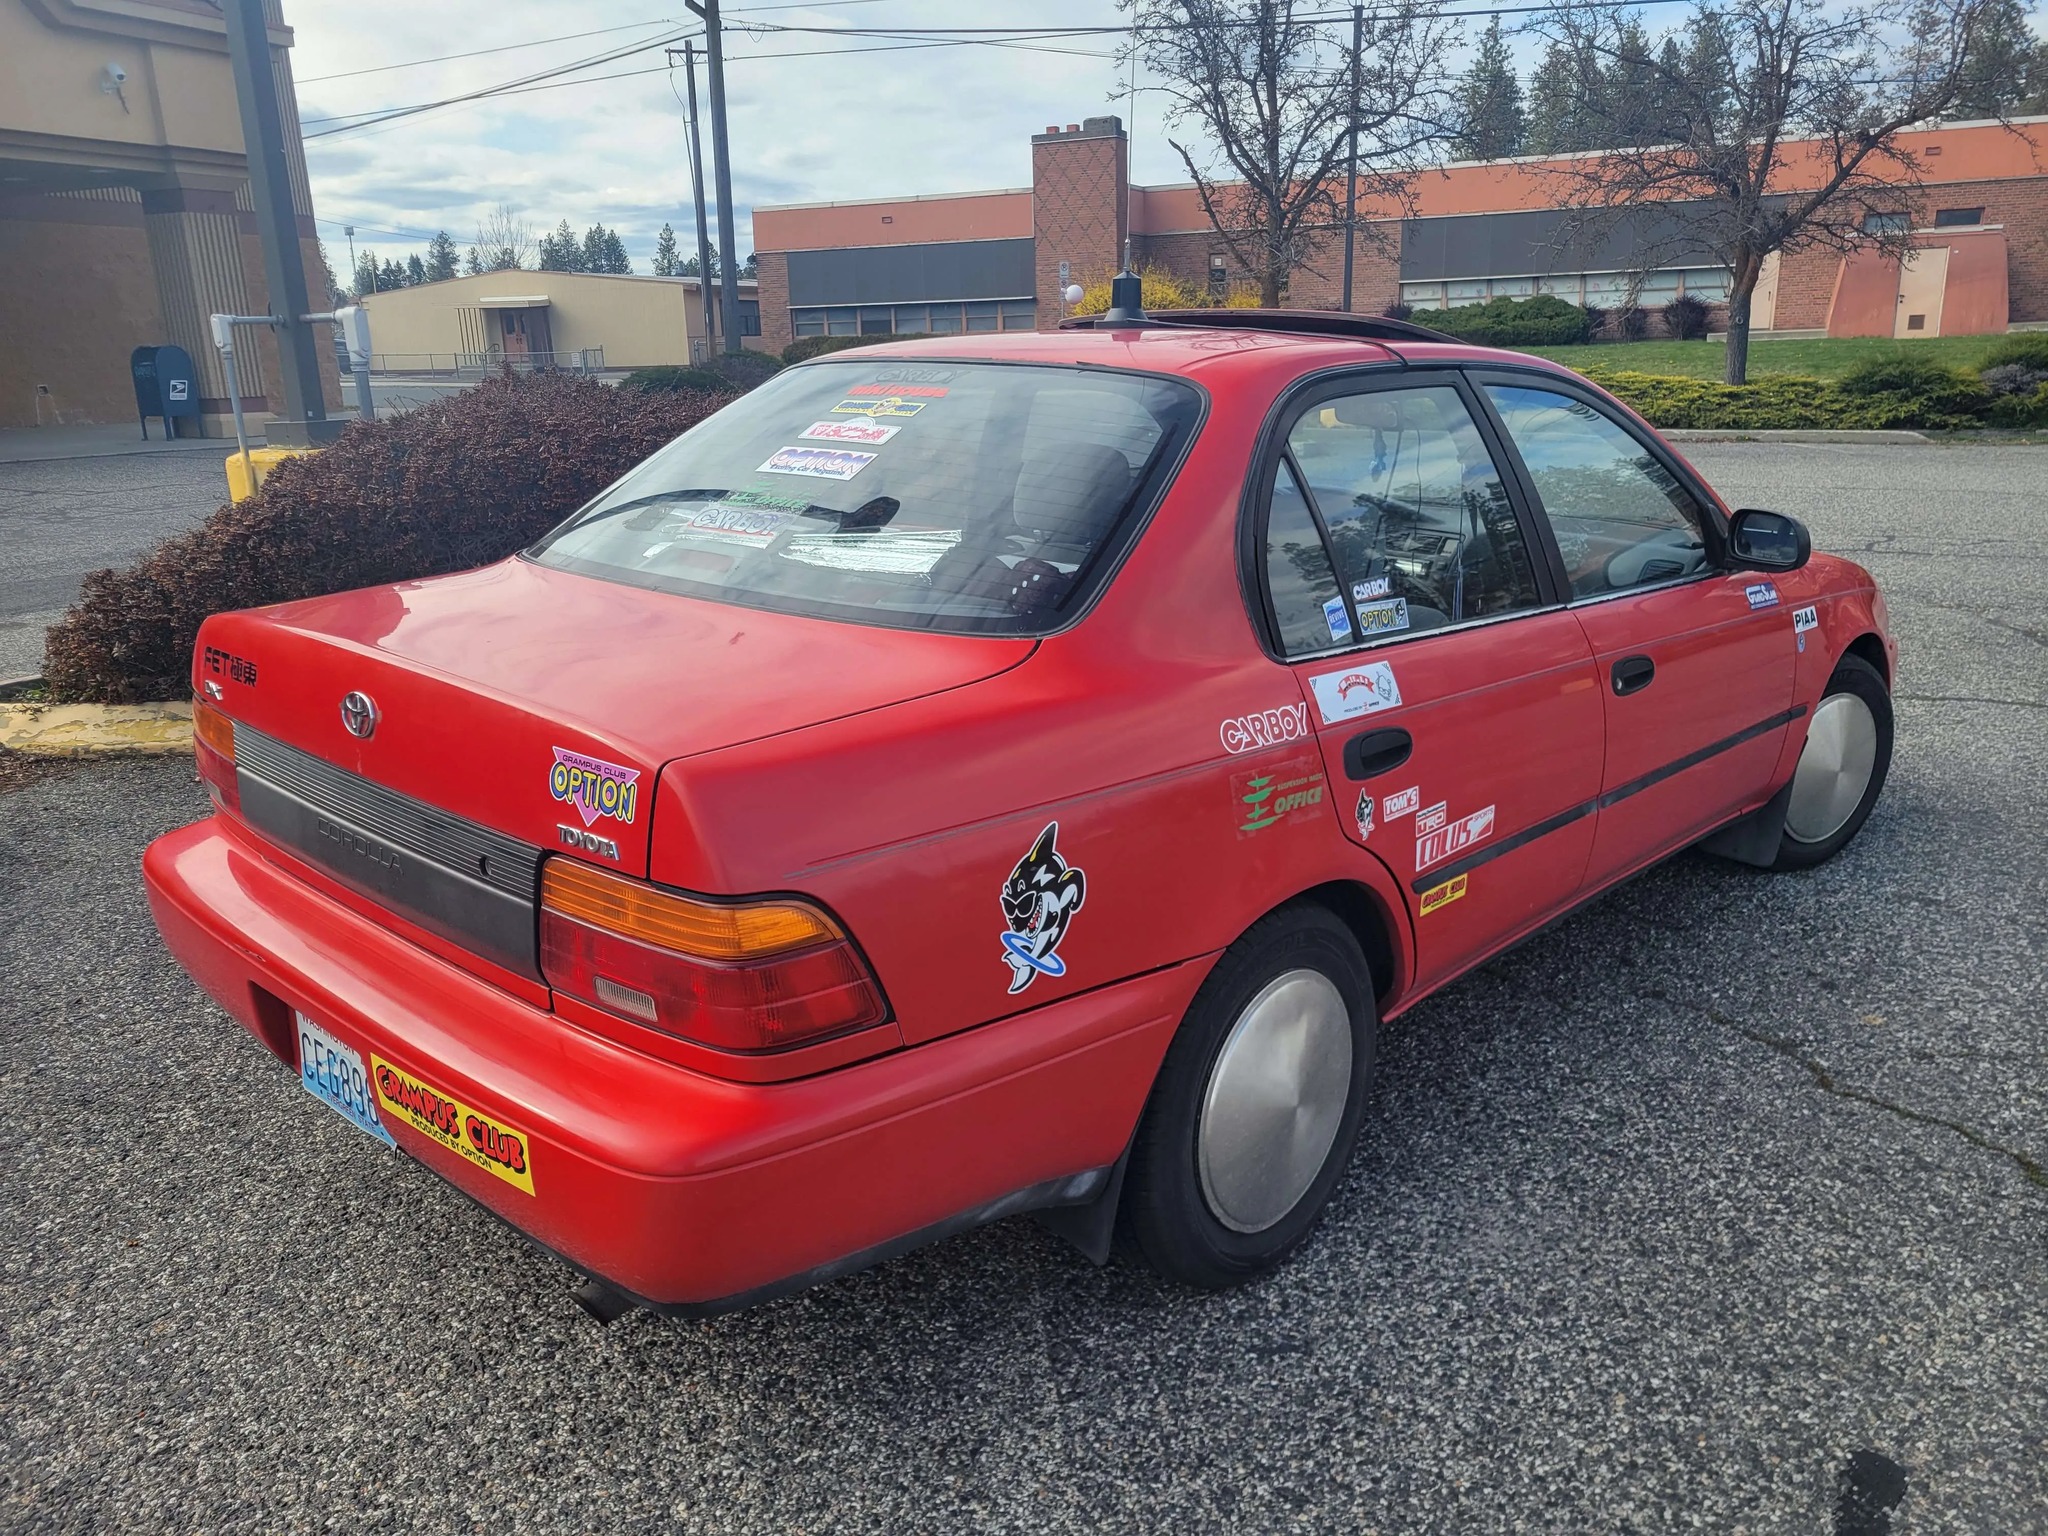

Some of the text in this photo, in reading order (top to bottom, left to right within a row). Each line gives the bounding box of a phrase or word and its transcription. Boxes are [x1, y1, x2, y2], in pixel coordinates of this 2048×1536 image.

[769, 448, 874, 475] OPTION
[692, 508, 793, 536] CARBOY
[1353, 577, 1390, 601] CARBOY
[1361, 608, 1397, 632] OPTION
[1794, 608, 1817, 629] PIAA
[1220, 701, 1308, 754] CARBOY
[562, 754, 627, 780] GRAMPUS CLUB
[550, 761, 636, 822] OPTION
[1274, 786, 1323, 814] OFFICE
[1385, 788, 1418, 815] TOM'S
[1473, 807, 1494, 823] SPORTS
[318, 816, 405, 877] COROLLA
[556, 823, 620, 861] TOYOTA
[376, 1064, 527, 1175] GRAMPUS CLUB
[410, 1115, 493, 1171] PRODUCED BY OPTION
